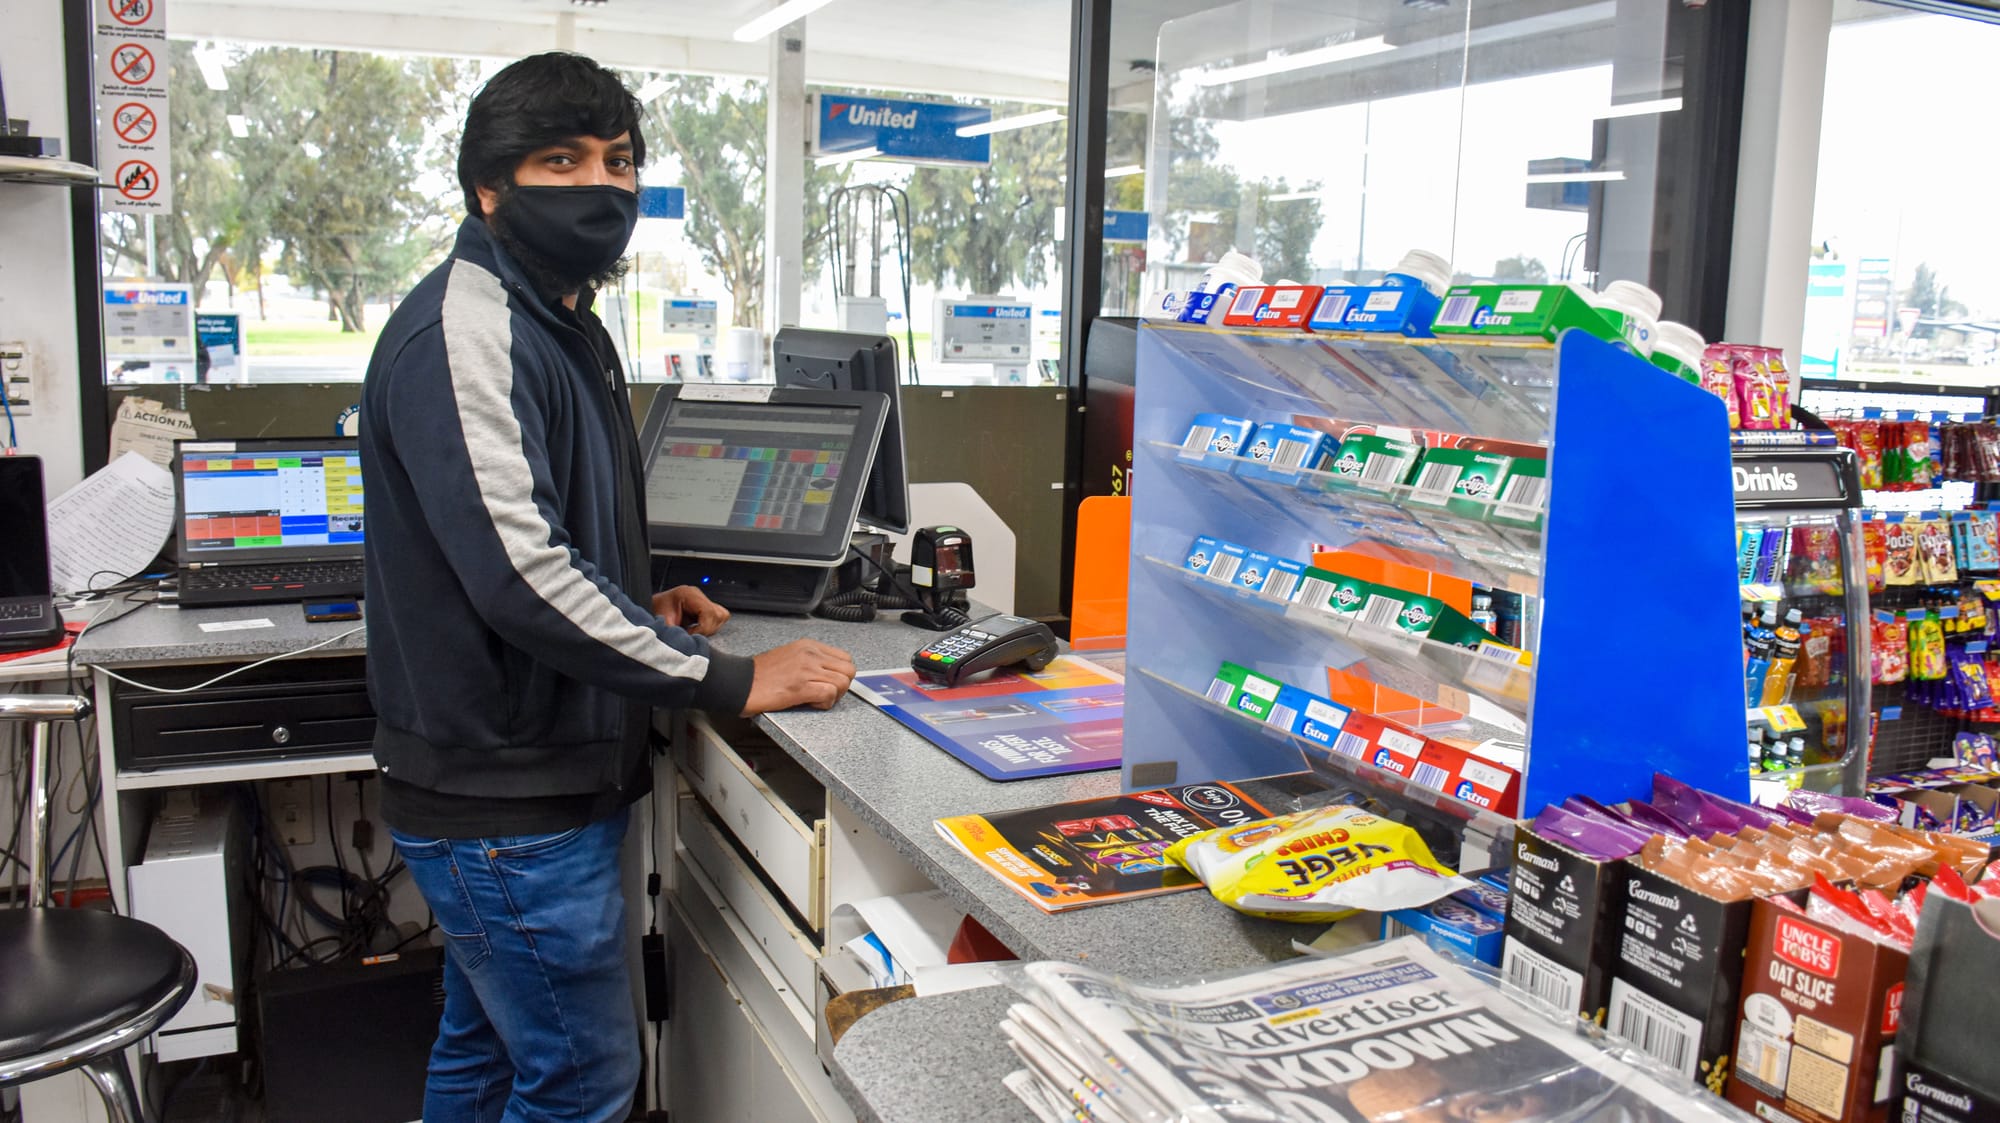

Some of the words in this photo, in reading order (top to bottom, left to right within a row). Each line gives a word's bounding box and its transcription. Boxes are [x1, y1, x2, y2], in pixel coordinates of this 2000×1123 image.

[848, 104, 918, 128] United
[138, 291, 182, 304] United
[946, 305, 953, 316] 5
[996, 307, 1027, 318] United
[1256, 307, 1282, 320] Extra
[1345, 308, 1377, 322] Extra
[1474, 310, 1512, 326] Extra
[134, 411, 176, 426] ACTION
[1211, 437, 1240, 452] eclipse
[1250, 443, 1274, 456] eclipse
[1334, 458, 1364, 474] eclipse
[1456, 477, 1494, 495] eclipse
[1732, 466, 1798, 492] Drinks
[1740, 536, 1757, 580] Mother
[1333, 590, 1362, 604] eclipse
[1401, 608, 1432, 624] eclipse
[1240, 695, 1262, 714] Extra
[1303, 722, 1329, 742] Extra
[994, 734, 1034, 754] EVERY
[1031, 750, 1062, 764] FOR
[1376, 751, 1404, 772] Extra
[1203, 790, 1226, 804] Enjoy
[1458, 784, 1490, 806] Extra
[1144, 808, 1167, 824] THE
[1162, 810, 1188, 824] MIX
[1276, 842, 1394, 886] VEGE
[1518, 842, 1560, 872] Carman's
[1628, 880, 1680, 912] Carman's
[1430, 922, 1472, 944] Peppermint
[1782, 922, 1832, 956] UNCLE
[1781, 938, 1832, 970] TOBYS
[1296, 982, 1335, 998] CROWS
[1769, 960, 1796, 988] OAT
[1794, 968, 1836, 1005] SLICE
[1780, 987, 1800, 1004] CHOC
[1799, 994, 1817, 1010] CHIP
[1214, 990, 1458, 1048] Advertiser
[1906, 1072, 1972, 1112] Carman's
